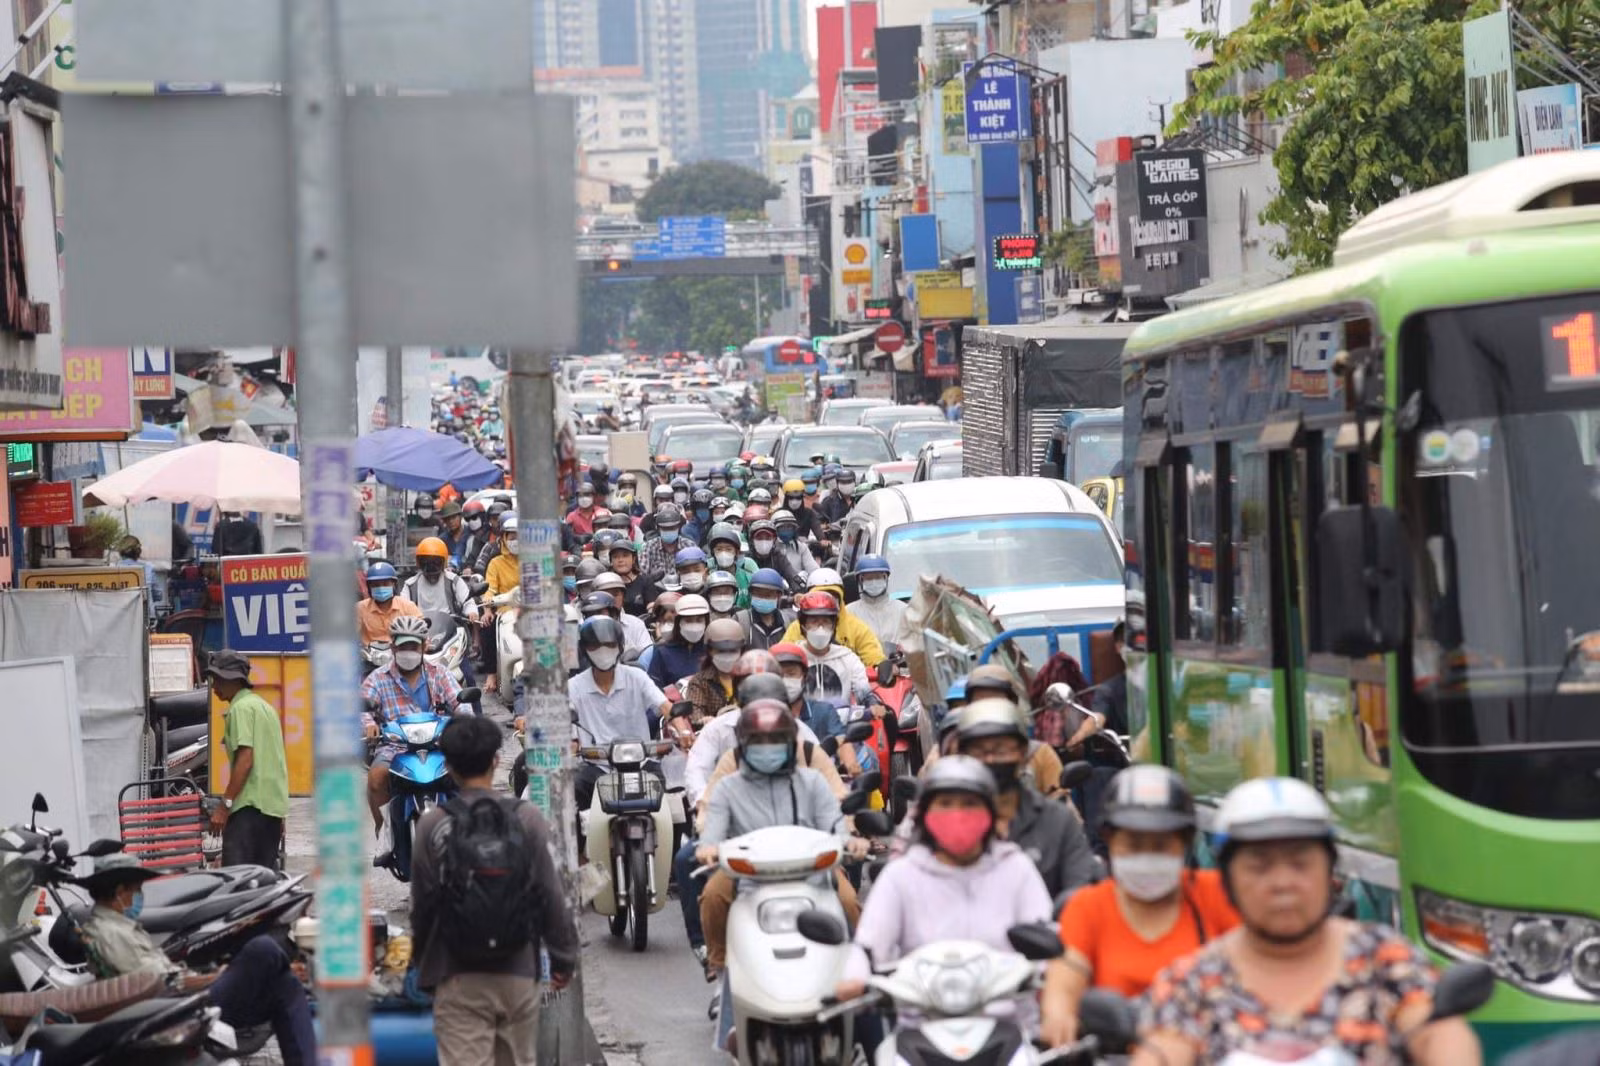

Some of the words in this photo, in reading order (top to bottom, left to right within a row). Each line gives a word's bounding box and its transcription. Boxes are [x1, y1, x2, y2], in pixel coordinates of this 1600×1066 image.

[1150, 168, 1199, 183] GAMES
[1173, 190, 1198, 203] GÓP
[1165, 207, 1182, 217] 0%
[230, 565, 248, 582] CÓ
